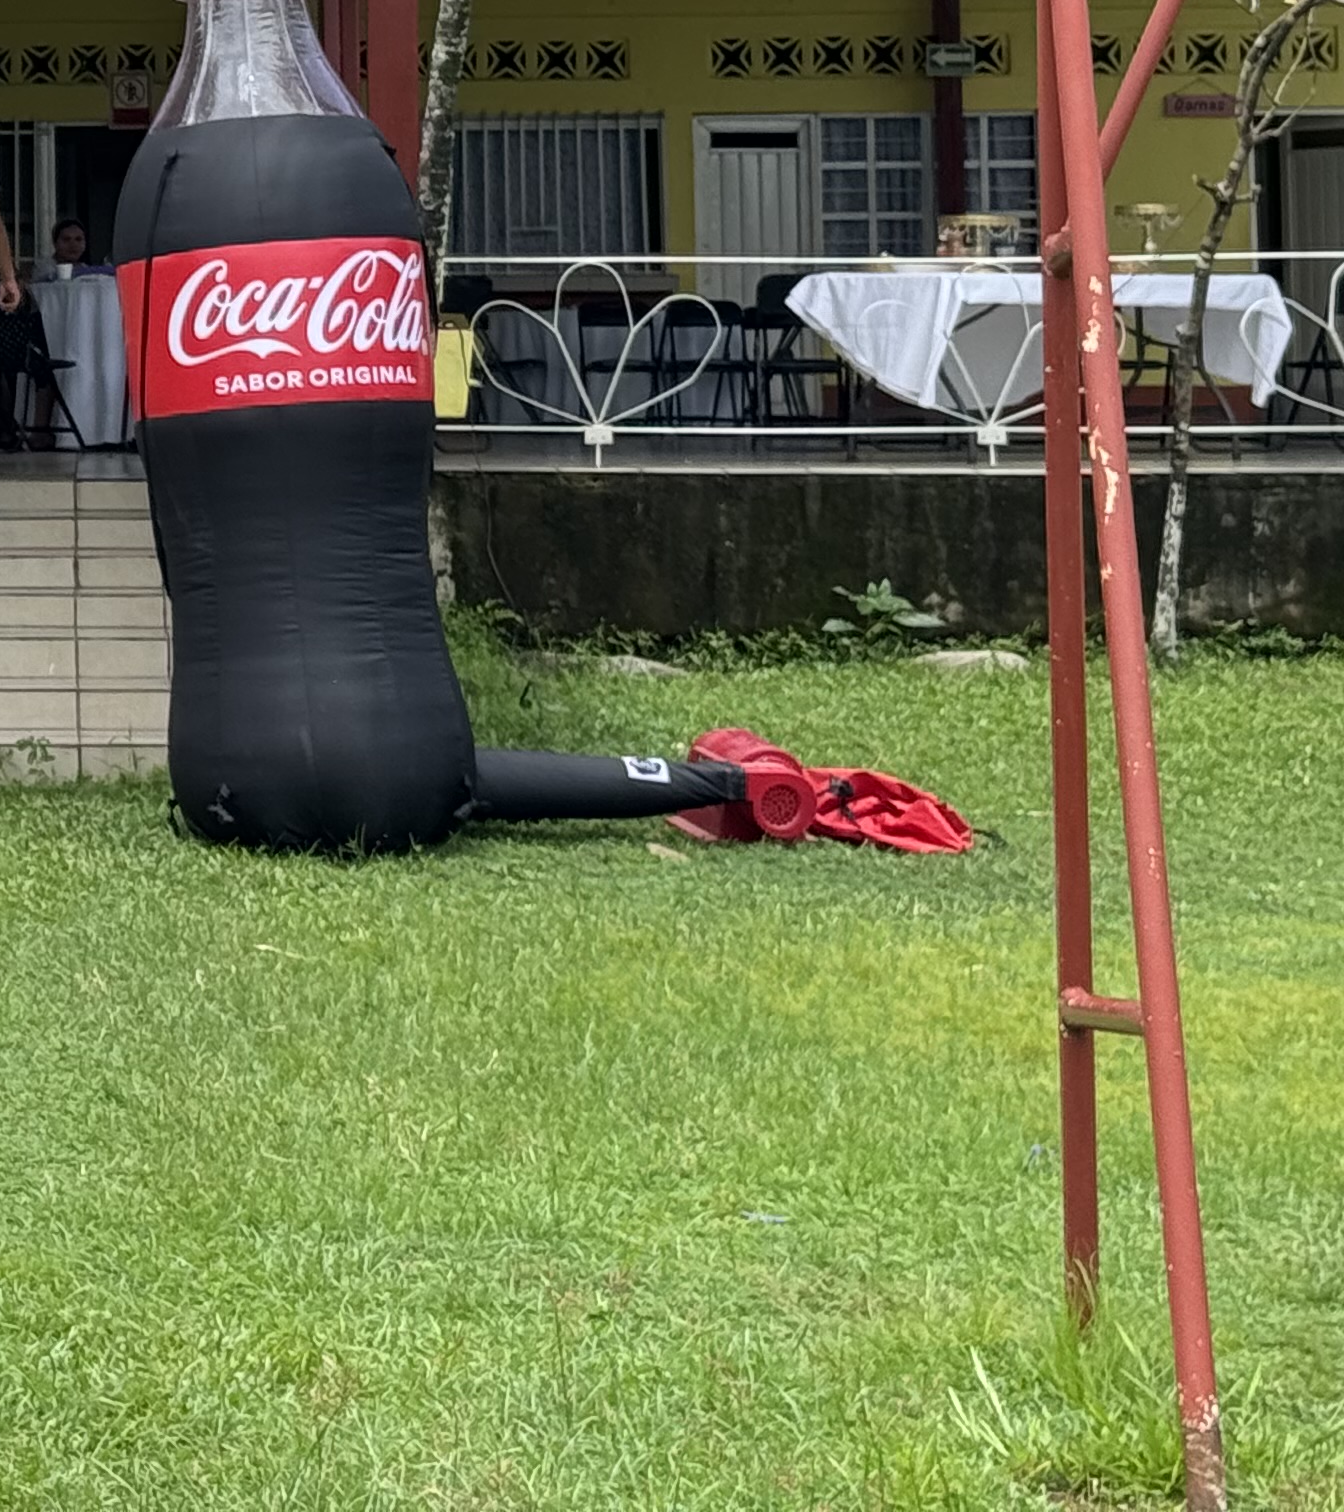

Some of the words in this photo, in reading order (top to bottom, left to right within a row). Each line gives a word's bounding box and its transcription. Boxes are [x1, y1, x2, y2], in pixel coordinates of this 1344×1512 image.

[1174, 97, 1226, 113] Damas
[167, 248, 425, 368] Coca-Cola
[214, 369, 305, 396] SABOR
[308, 364, 417, 387] ORIGINAL
